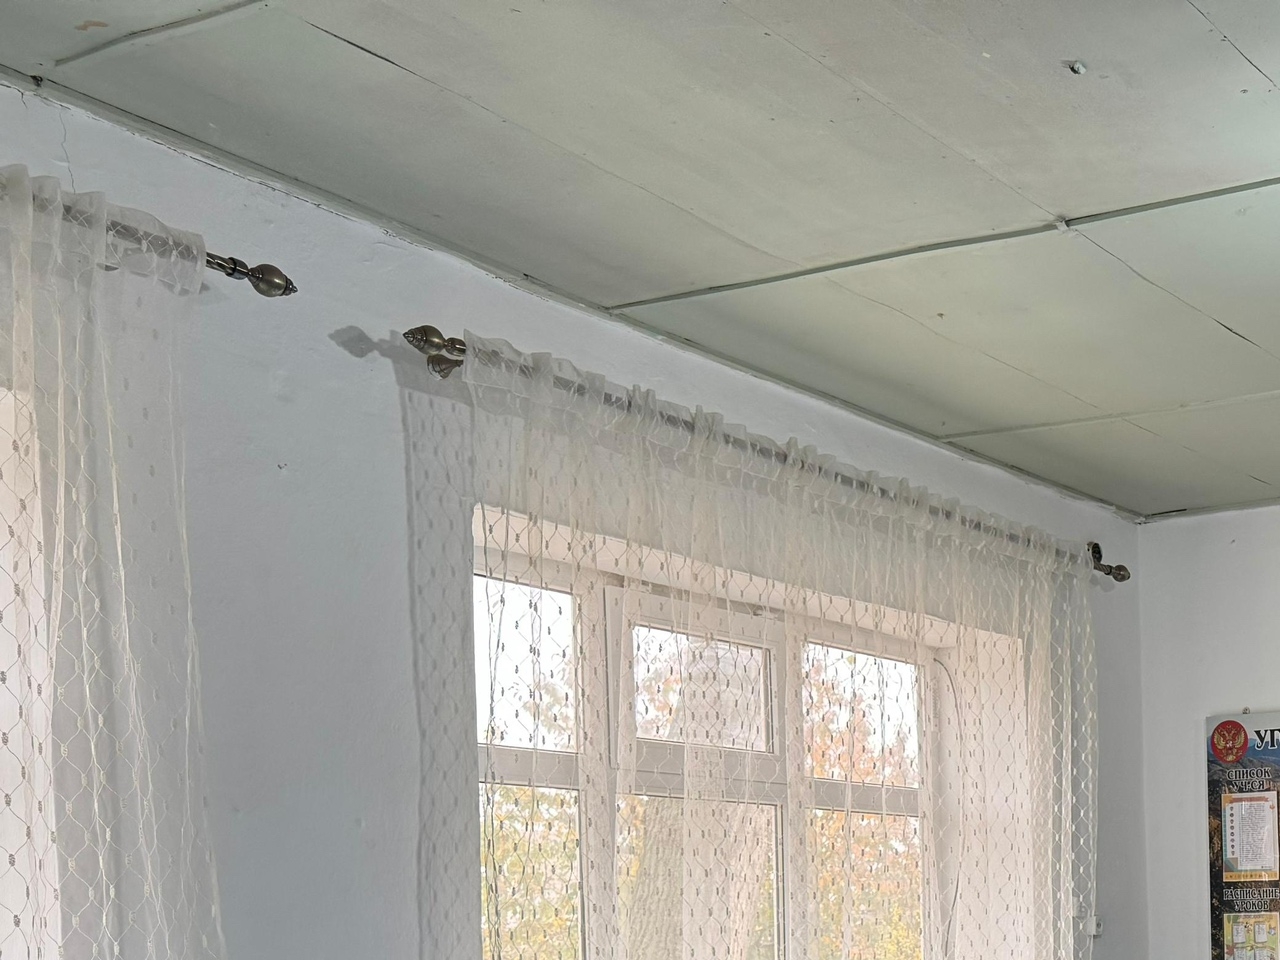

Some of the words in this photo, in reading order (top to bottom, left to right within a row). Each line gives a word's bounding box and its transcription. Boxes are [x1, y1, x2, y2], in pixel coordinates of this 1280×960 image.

[1227, 768, 1271, 780] СПИСОК
[1223, 888, 1280, 900] РАСПИСАНИЕ
[1234, 900, 1270, 911] УРОКОВ
